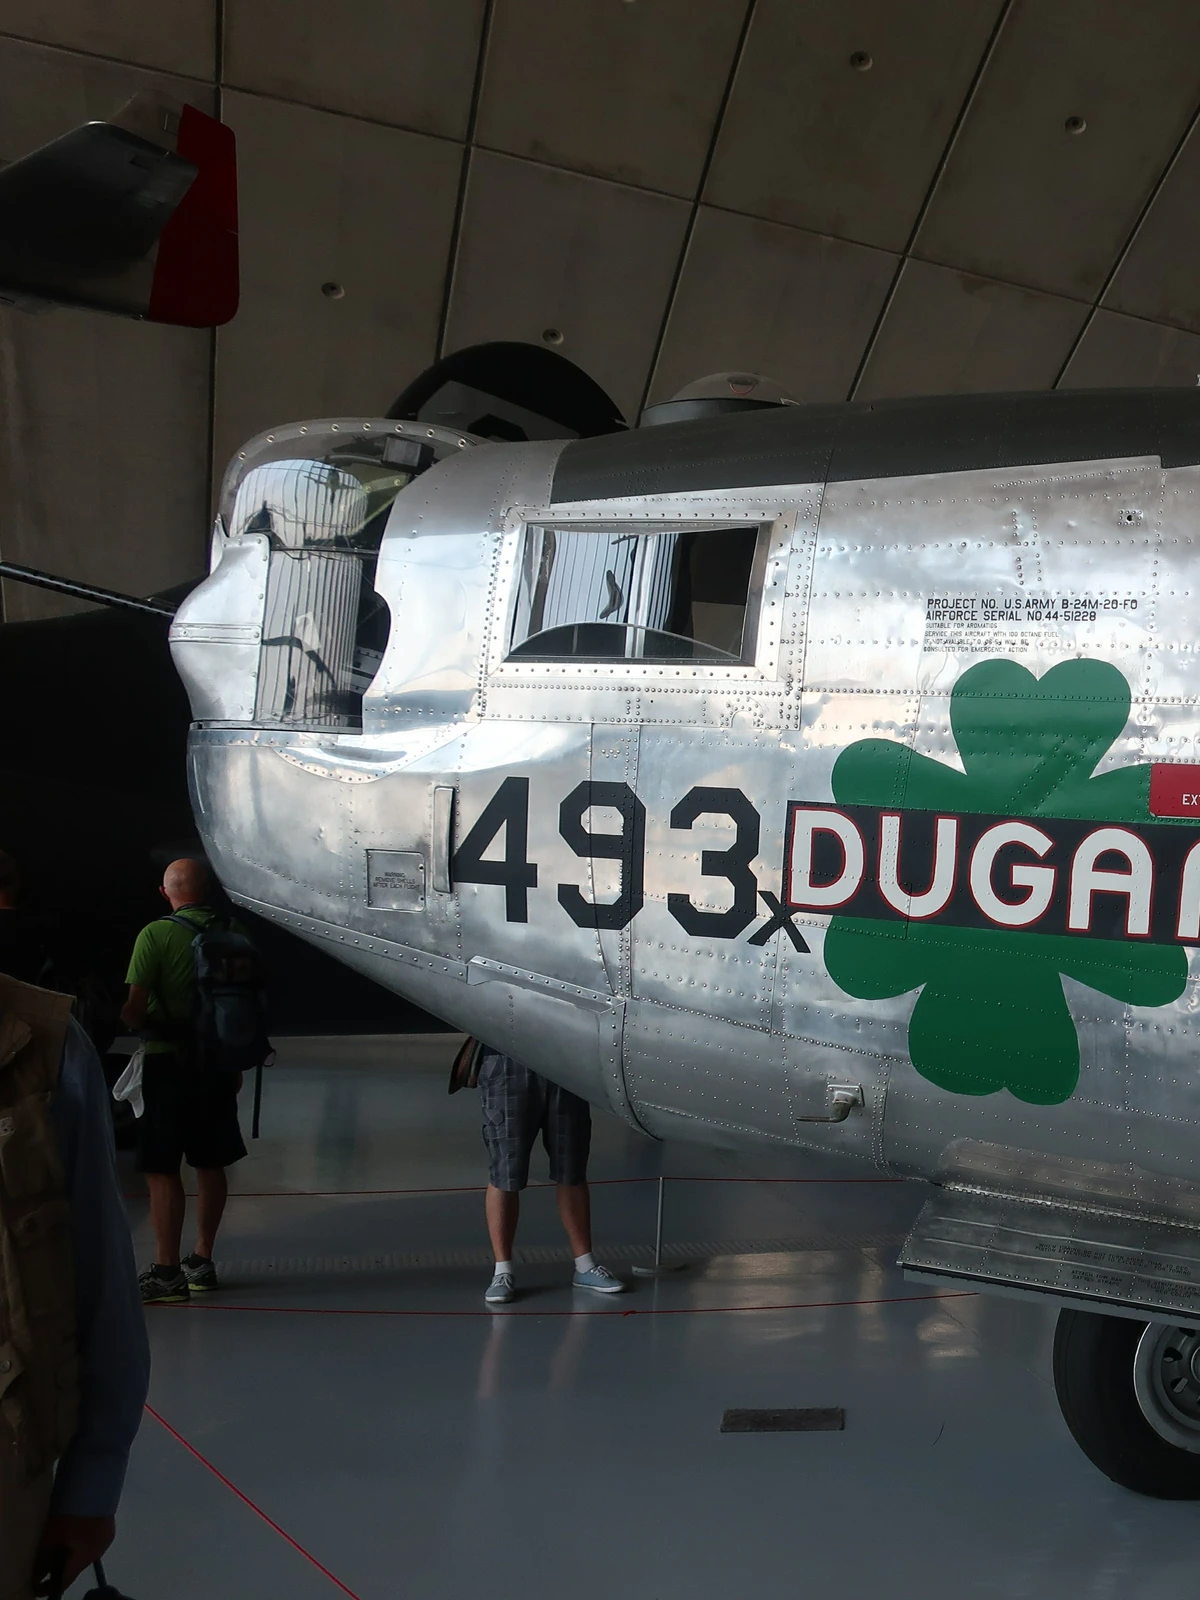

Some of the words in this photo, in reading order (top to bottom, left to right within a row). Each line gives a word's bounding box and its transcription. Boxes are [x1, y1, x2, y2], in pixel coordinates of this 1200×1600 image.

[927, 598, 977, 609] PROJECT
[981, 598, 999, 609] NO.
[1004, 598, 1056, 610] U.S.ARMY
[925, 610, 978, 621] AIRFORCE
[983, 610, 1022, 621] SERIAL
[453, 776, 761, 939] 493
[1059, 1245, 1080, 1253] TOWING
[1071, 1269, 1094, 1277] ATTACH
[1168, 1267, 1192, 1276] TOWING
